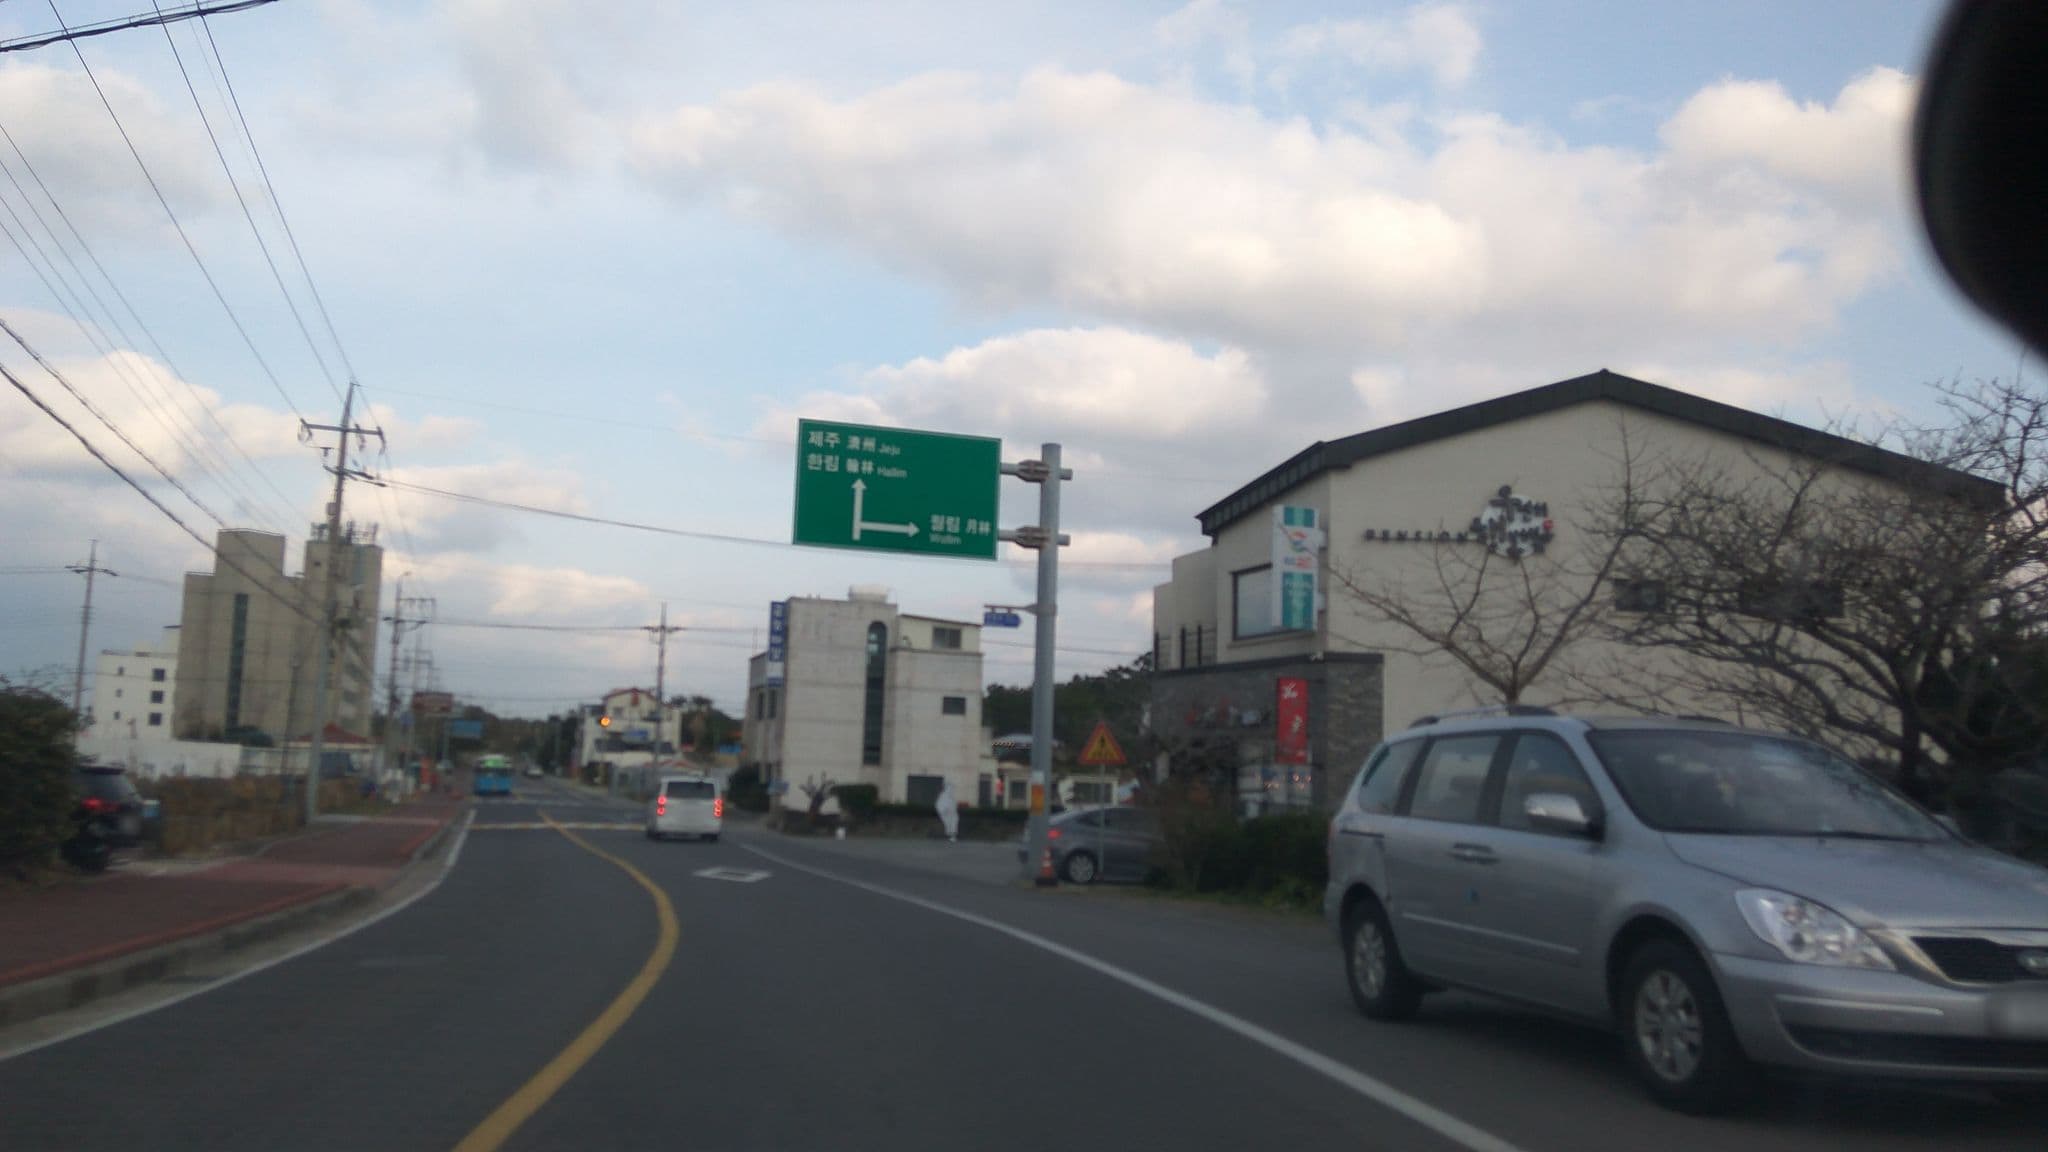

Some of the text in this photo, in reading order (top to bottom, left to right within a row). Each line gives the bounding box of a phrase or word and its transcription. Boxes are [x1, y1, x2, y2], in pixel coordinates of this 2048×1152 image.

[808, 431, 840, 448] 제주
[879, 444, 900, 456] Jeju
[808, 453, 839, 472] 한림
